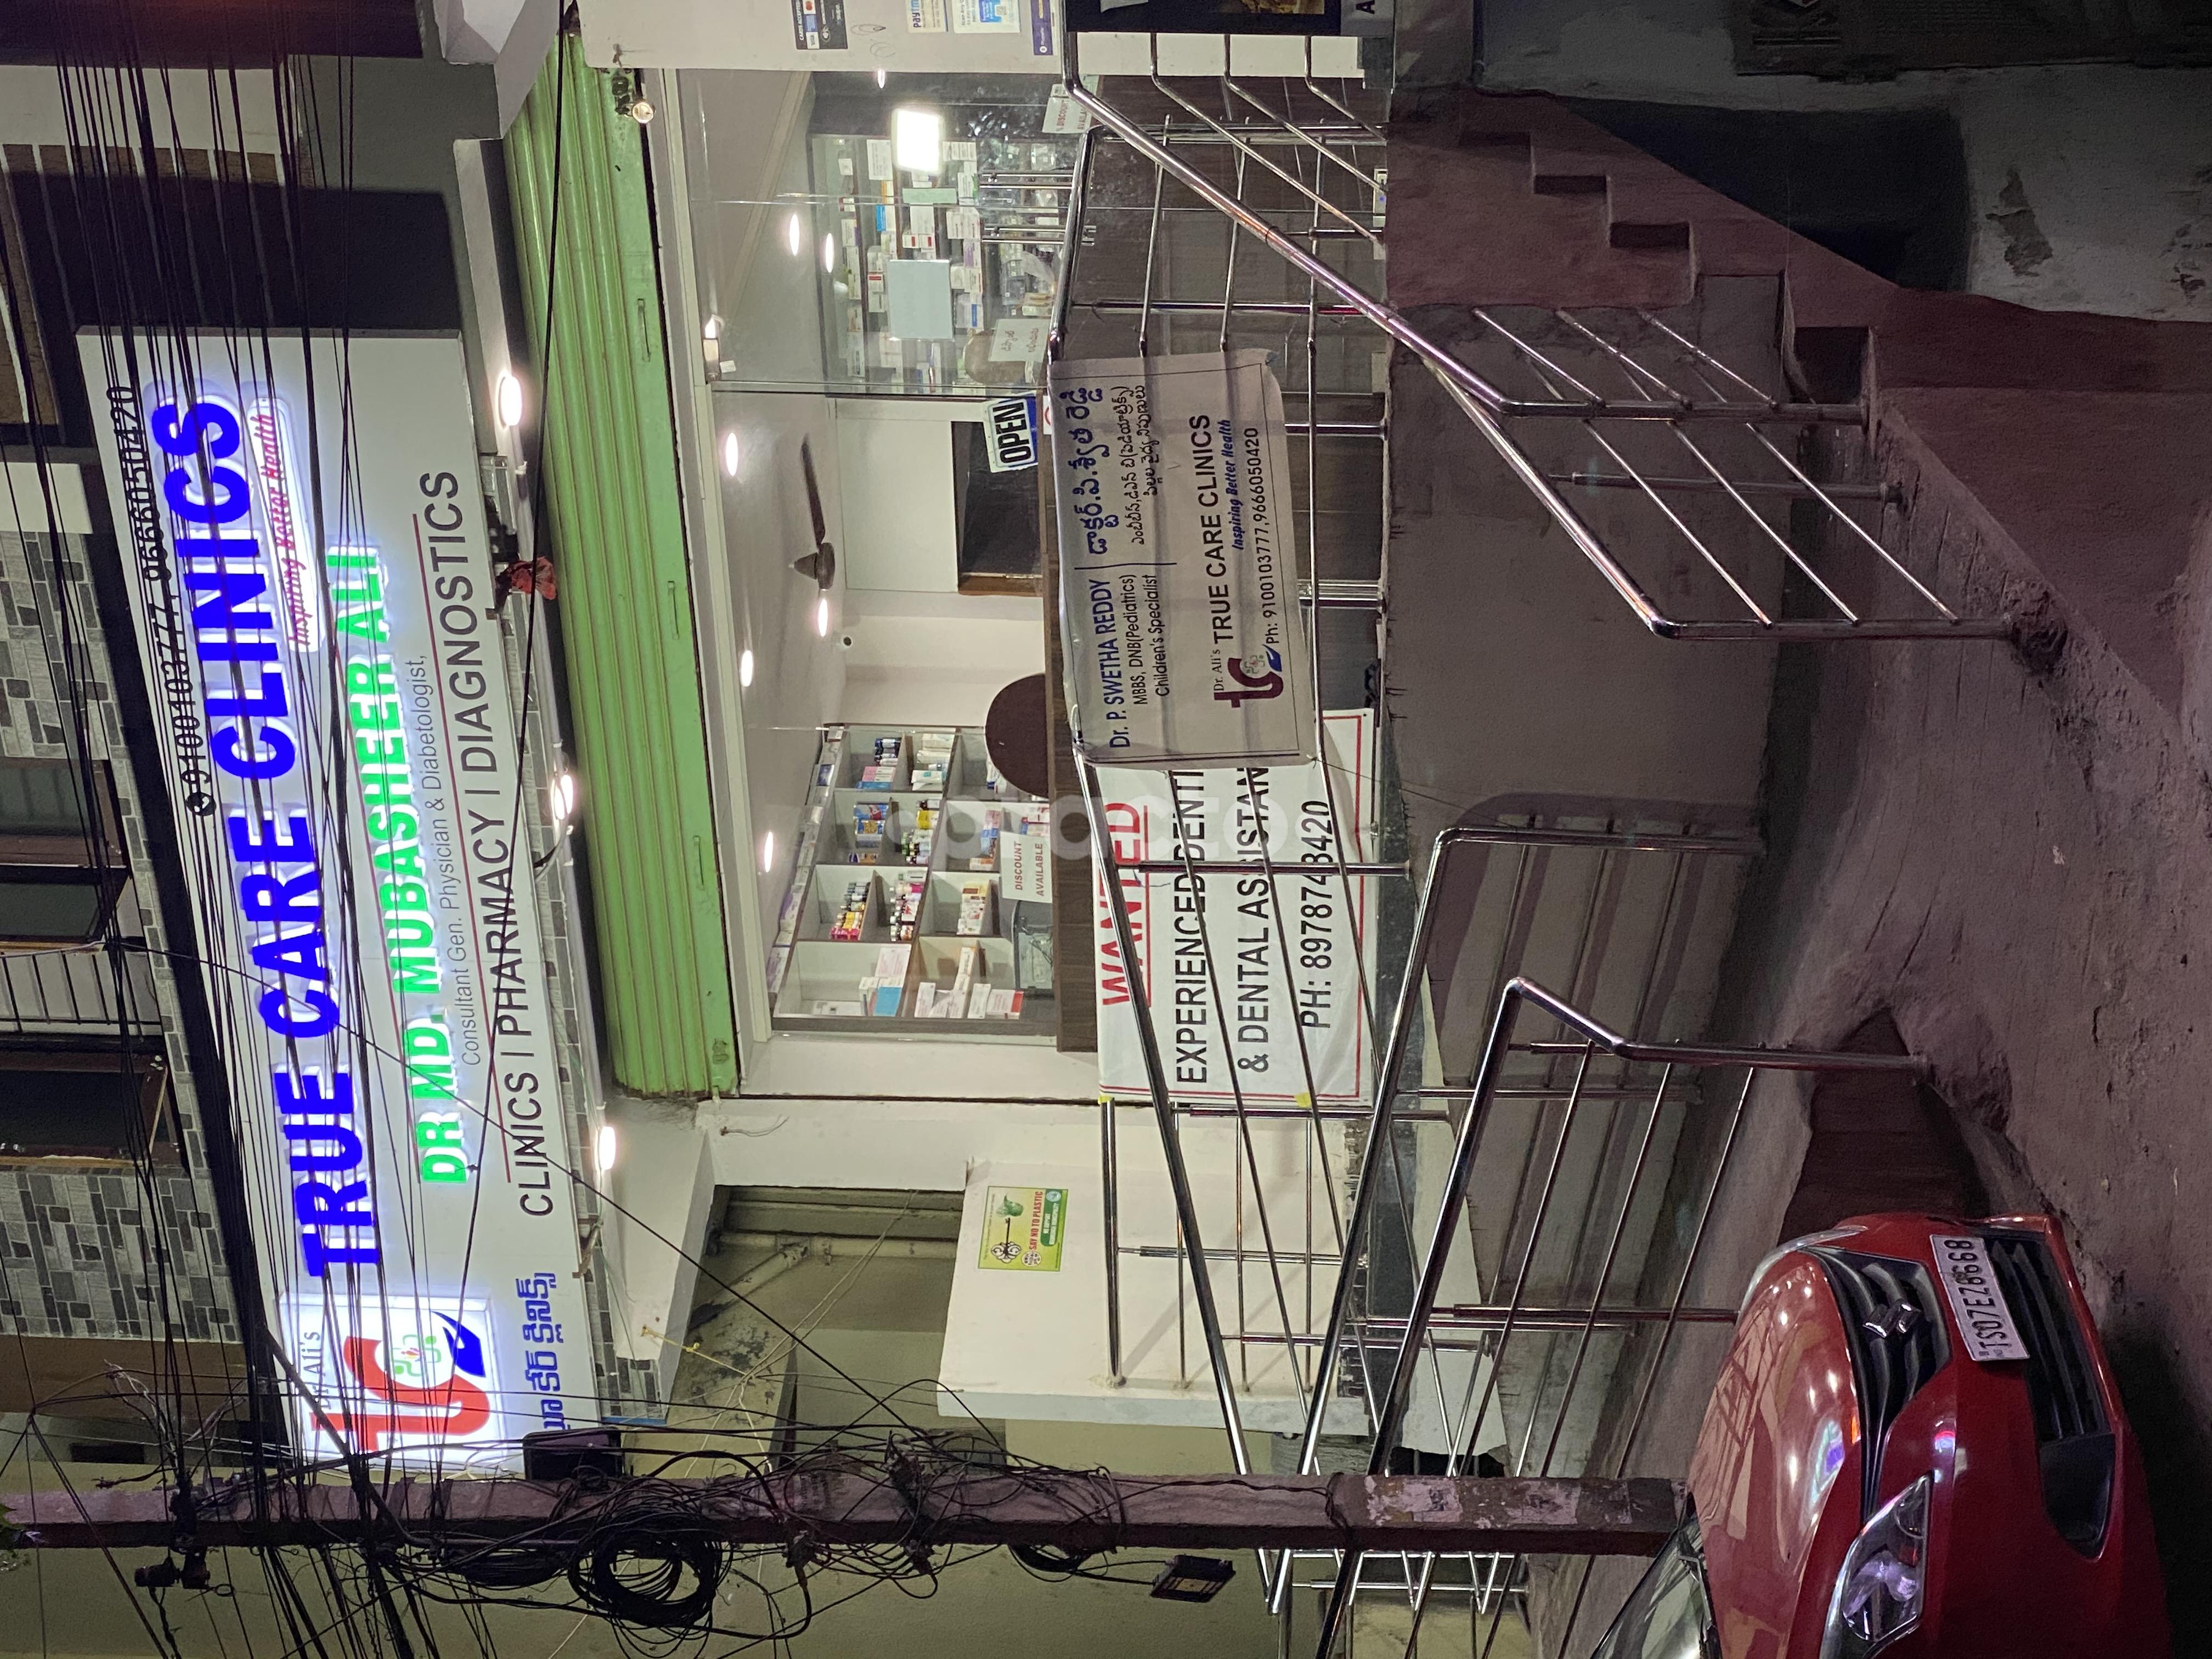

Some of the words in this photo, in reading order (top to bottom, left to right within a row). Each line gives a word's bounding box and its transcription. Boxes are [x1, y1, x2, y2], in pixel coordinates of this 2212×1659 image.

[992, 402, 1031, 463] OPEN
[1189, 415, 1218, 507] CLINICS
[1217, 420, 1233, 458] Health
[1224, 460, 1238, 495] Better
[1200, 515, 1226, 578] CARE
[1227, 499, 1245, 550] Inspiring
[151, 402, 297, 780] CLINICS
[326, 554, 388, 642] ALI
[1089, 579, 1116, 635] REDDY
[1119, 574, 1143, 667] DNB(Pediatrics)
[1142, 574, 1165, 634] Specialist
[1208, 584, 1233, 644] TRUE
[419, 471, 497, 772] DIAGNOSTICS
[1265, 623, 1279, 644] Ph:
[1098, 638, 1124, 705] SWETHA
[1130, 672, 1148, 704] MBBS,
[1150, 637, 1170, 696] Children's
[1210, 649, 1222, 674] Ali's
[1213, 677, 1224, 691] Dr.
[404, 654, 442, 789] Diabetologist,
[1106, 710, 1126, 720] P.
[1109, 727, 1130, 748] Dr.
[343, 661, 441, 994] MUBASHEER
[425, 798, 444, 810] &
[430, 819, 464, 909] Physician
[1013, 841, 1023, 890] DISCOUNT
[1035, 843, 1045, 896] AVAILABLE
[228, 815, 340, 1039] CARE
[466, 810, 532, 1035] PHARMACY
[1099, 803, 1143, 1005] WANTED
[444, 918, 468, 962] Gen.
[1173, 873, 1206, 1084] EXPERIENCED
[1237, 927, 1269, 1043] DENTAL
[1300, 980, 1331, 1028] PH:
[450, 969, 482, 1065] Consultant
[402, 1013, 455, 1099] MD.
[1237, 1054, 1269, 1072] &
[273, 1070, 381, 1277] TRUE
[419, 1119, 469, 1184] DR
[503, 1072, 553, 1216] CLINICS
[1030, 1228, 1039, 1237] NO
[1033, 1192, 1042, 1217] PLASTIC
